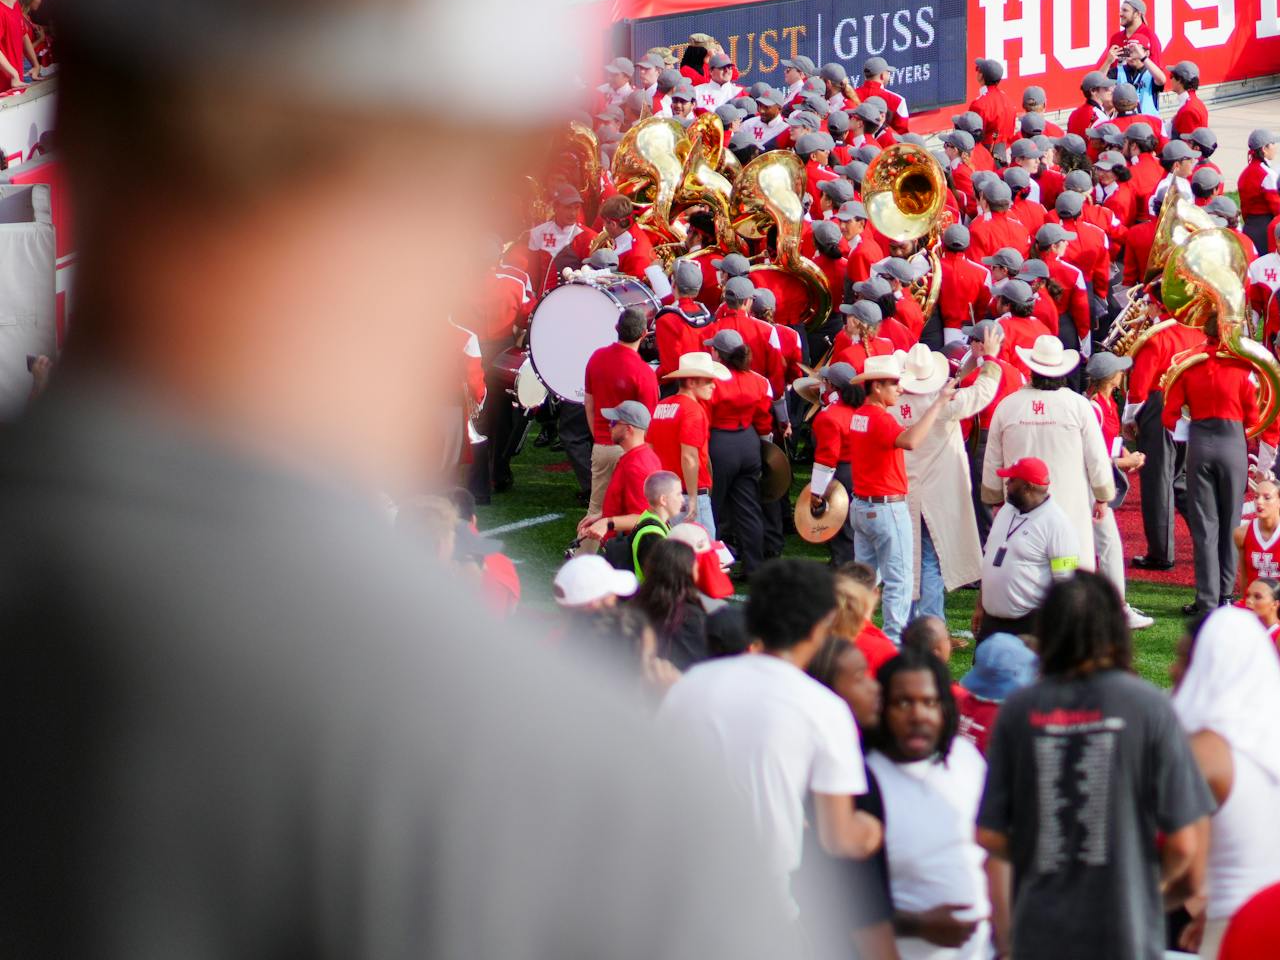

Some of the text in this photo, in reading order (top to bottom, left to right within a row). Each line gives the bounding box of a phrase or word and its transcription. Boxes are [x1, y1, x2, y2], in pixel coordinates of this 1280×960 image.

[667, 5, 935, 78] TUST GUSS
[889, 62, 931, 87] WYERS
